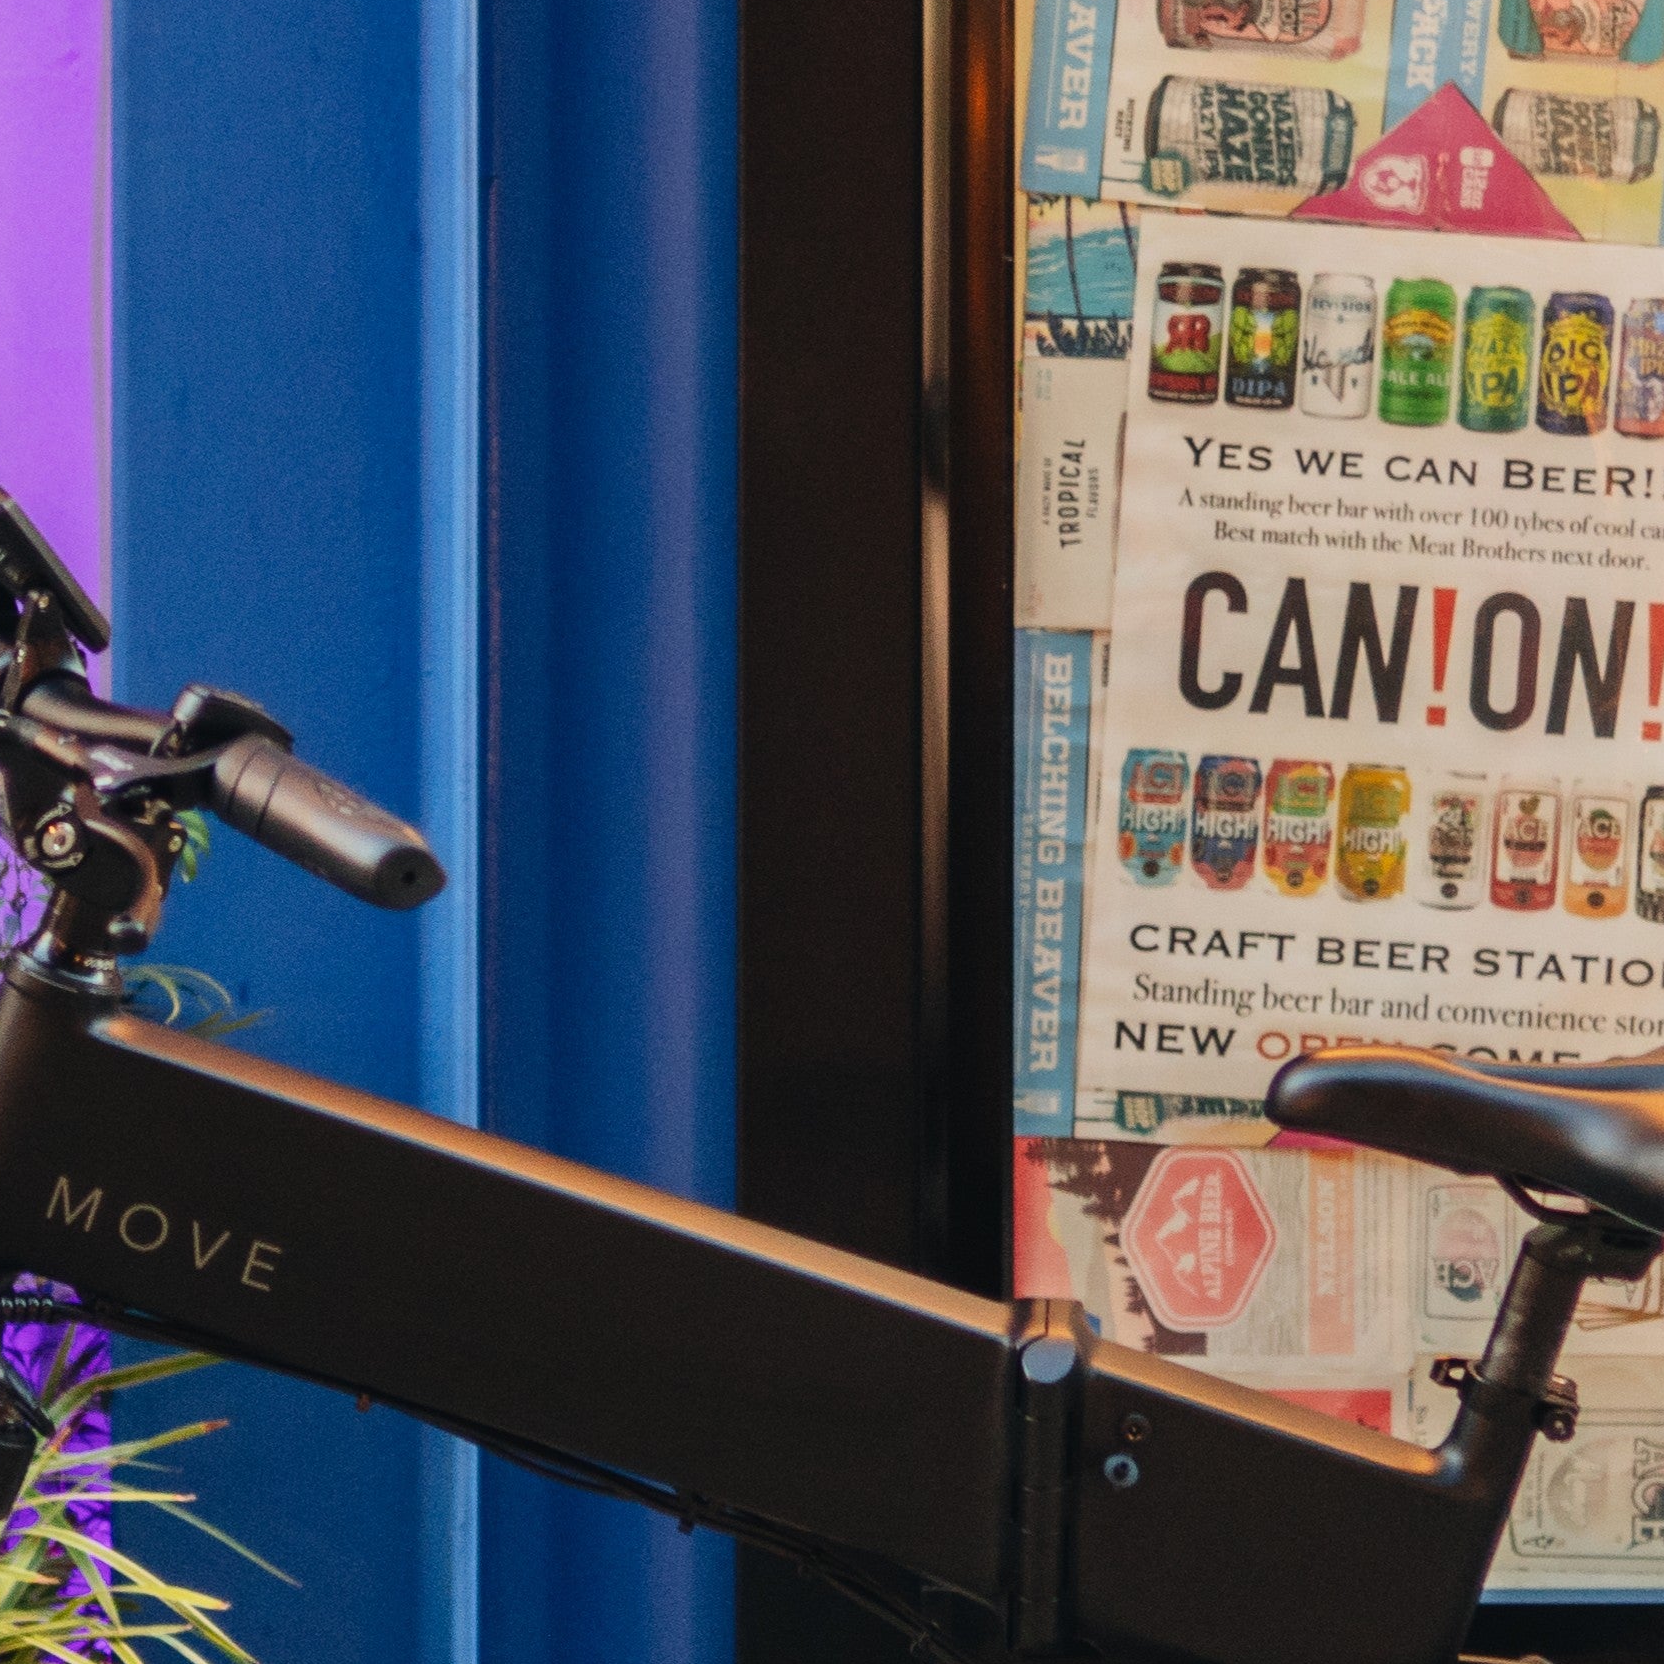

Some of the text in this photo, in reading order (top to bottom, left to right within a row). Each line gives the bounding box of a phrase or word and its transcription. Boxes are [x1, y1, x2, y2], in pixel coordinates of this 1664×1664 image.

[1218, 85, 1250, 182] HAZE
[1183, 435, 1274, 472] YES
[1294, 447, 1364, 479] WE
[1384, 454, 1478, 488] CAN
[1057, 438, 1086, 549] TROPICAL
[1086, 466, 1100, 519] FLAVORS
[1179, 487, 1193, 507] A
[1199, 490, 1283, 517] standing
[1288, 494, 1331, 517] beer
[1337, 498, 1369, 519] bar
[1373, 503, 1414, 523] with
[1420, 508, 1462, 526] over
[1470, 507, 1508, 529] 100
[1569, 516, 1592, 535] of
[1593, 519, 1635, 538] cool
[1214, 520, 1650, 571] Best match with the Meat Brothers next door.
[1029, 652, 1074, 1073] BELCHING BEAVER
[1129, 923, 1296, 963] CRAFT
[1316, 937, 1450, 974] BEER
[1132, 971, 1255, 1018] Standing
[1262, 982, 1323, 1014] beer
[1330, 987, 1375, 1018] bar
[1380, 992, 1429, 1023] and
[1437, 1003, 1607, 1035] convenience
[1113, 1019, 1237, 1058] NEW
[1255, 1030, 1412, 1061] OP
[46, 1175, 283, 1292] MOVE
[1316, 1178, 1335, 1297] NELSON
[1197, 1228, 1222, 1299] ALPINE
[1431, 1257, 1499, 1290] ACE
